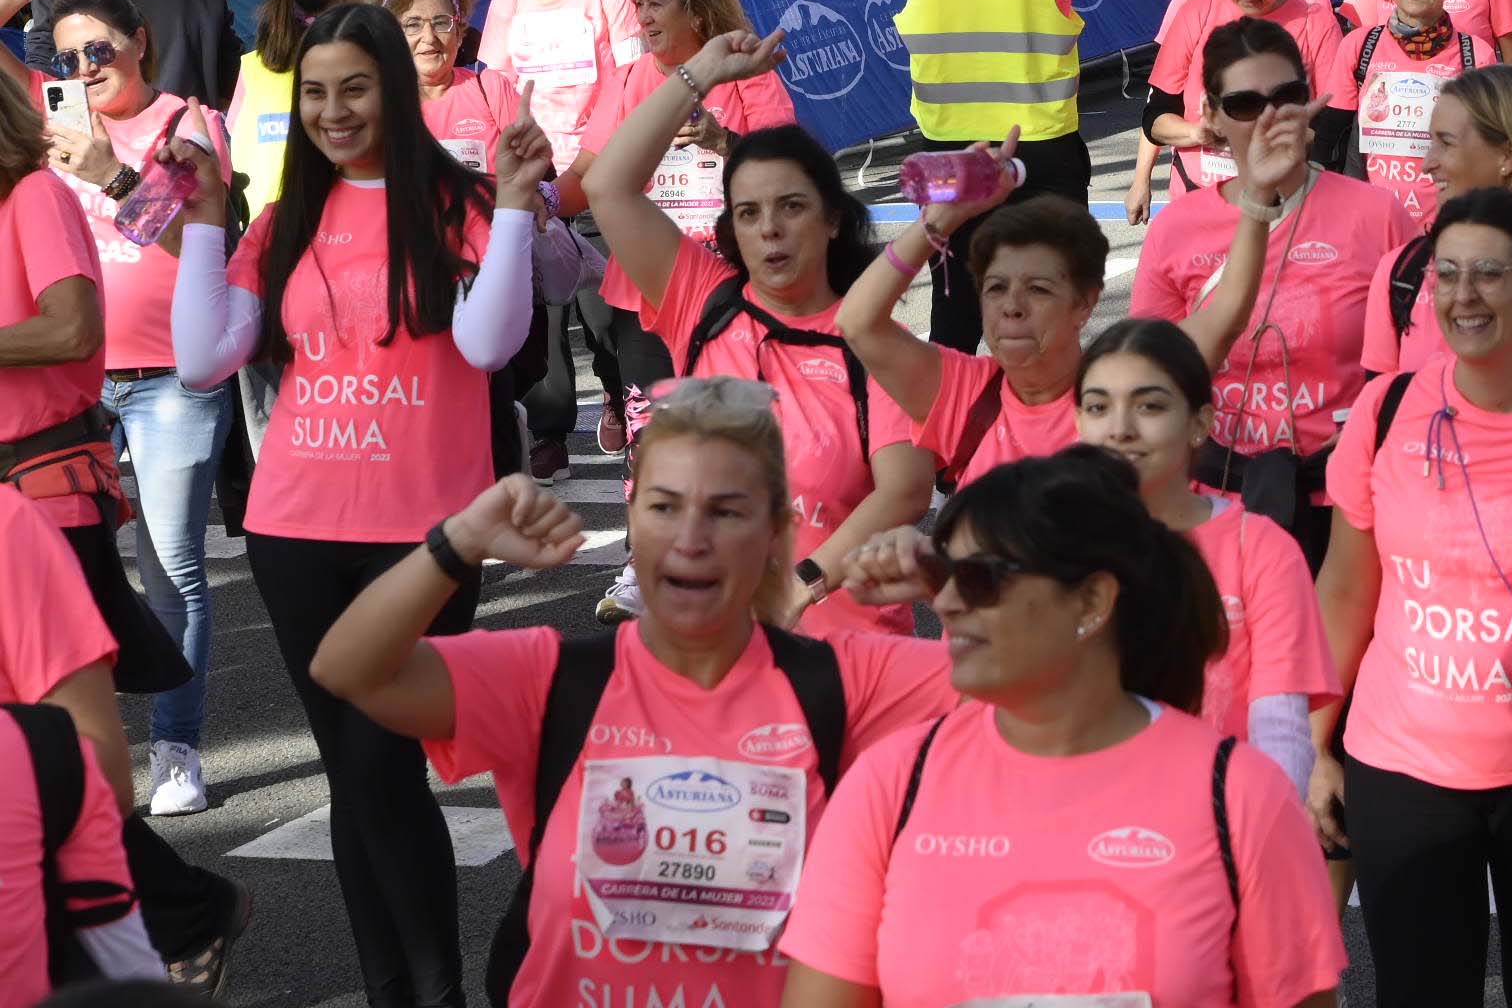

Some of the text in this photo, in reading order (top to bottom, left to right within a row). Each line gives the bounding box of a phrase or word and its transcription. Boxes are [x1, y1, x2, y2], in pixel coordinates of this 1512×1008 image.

[786, 39, 861, 82] ASTURIANA
[1392, 84, 1428, 95] ASTURIANA
[1391, 104, 1424, 118] 016
[657, 173, 689, 186] 016
[659, 190, 686, 198] 26946
[295, 374, 425, 407] DORSAL
[290, 415, 388, 451] SUMA
[1213, 411, 1293, 446] SUMA
[1391, 555, 1431, 590] TU
[1404, 646, 1512, 691] SUMA
[655, 785, 734, 804] ASTURIANA
[654, 825, 728, 855] 016
[914, 833, 1011, 858] OYSHO
[657, 860, 716, 882] 27890
[601, 883, 660, 897] CARRERA
[661, 886, 680, 899] DE
[681, 888, 699, 900] LA
[699, 889, 745, 904] MUJER
[577, 977, 726, 1008] SUMA
